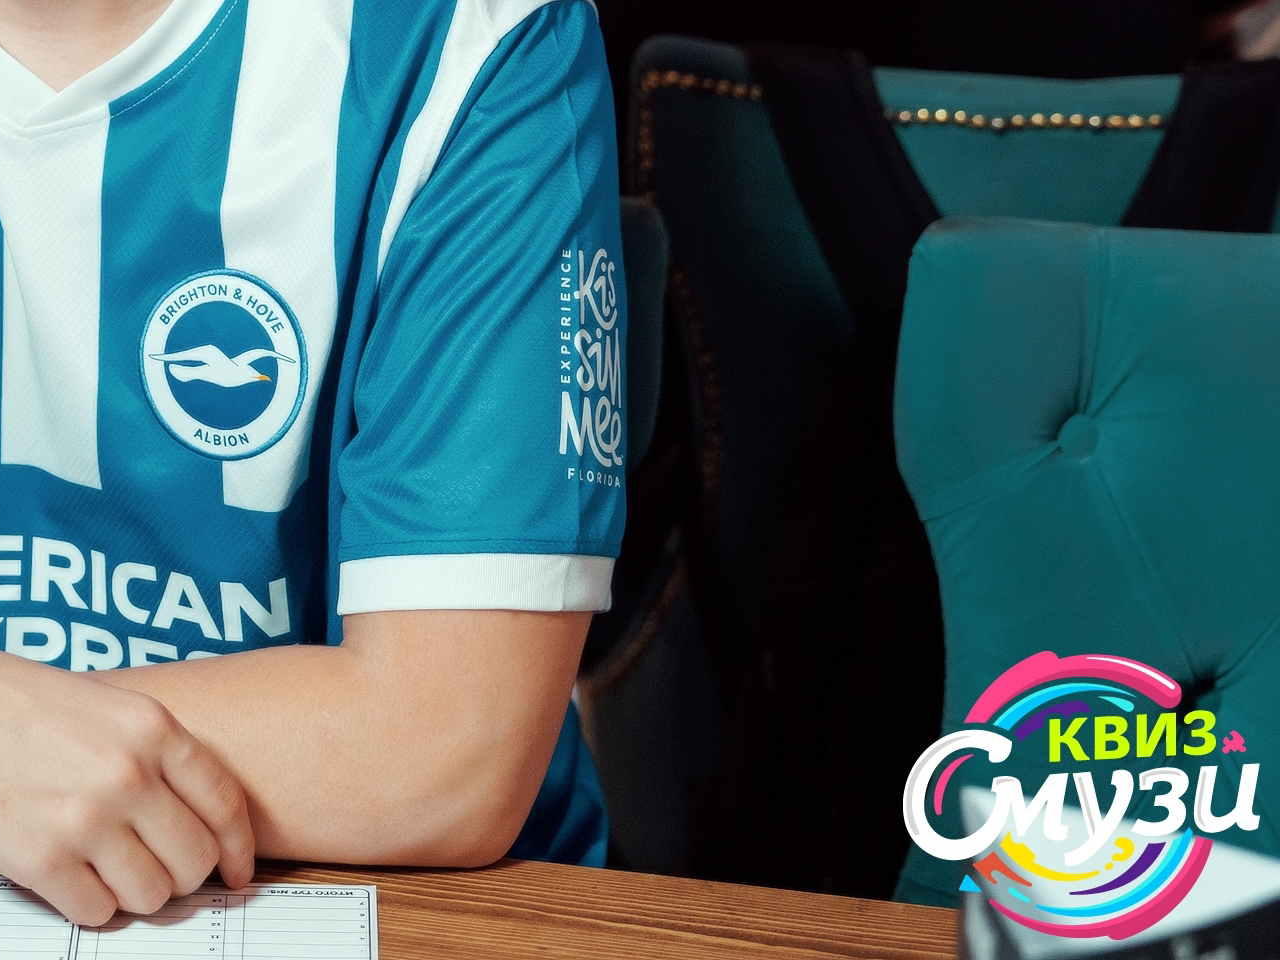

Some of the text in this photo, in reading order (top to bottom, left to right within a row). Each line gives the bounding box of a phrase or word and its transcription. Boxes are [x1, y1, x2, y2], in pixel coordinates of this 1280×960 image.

[159, 284, 285, 334] BRIGHTON & HOVE
[560, 249, 572, 384] EXPERIENCE
[193, 428, 250, 447] ALBION
[567, 467, 621, 488] FLORIDA
